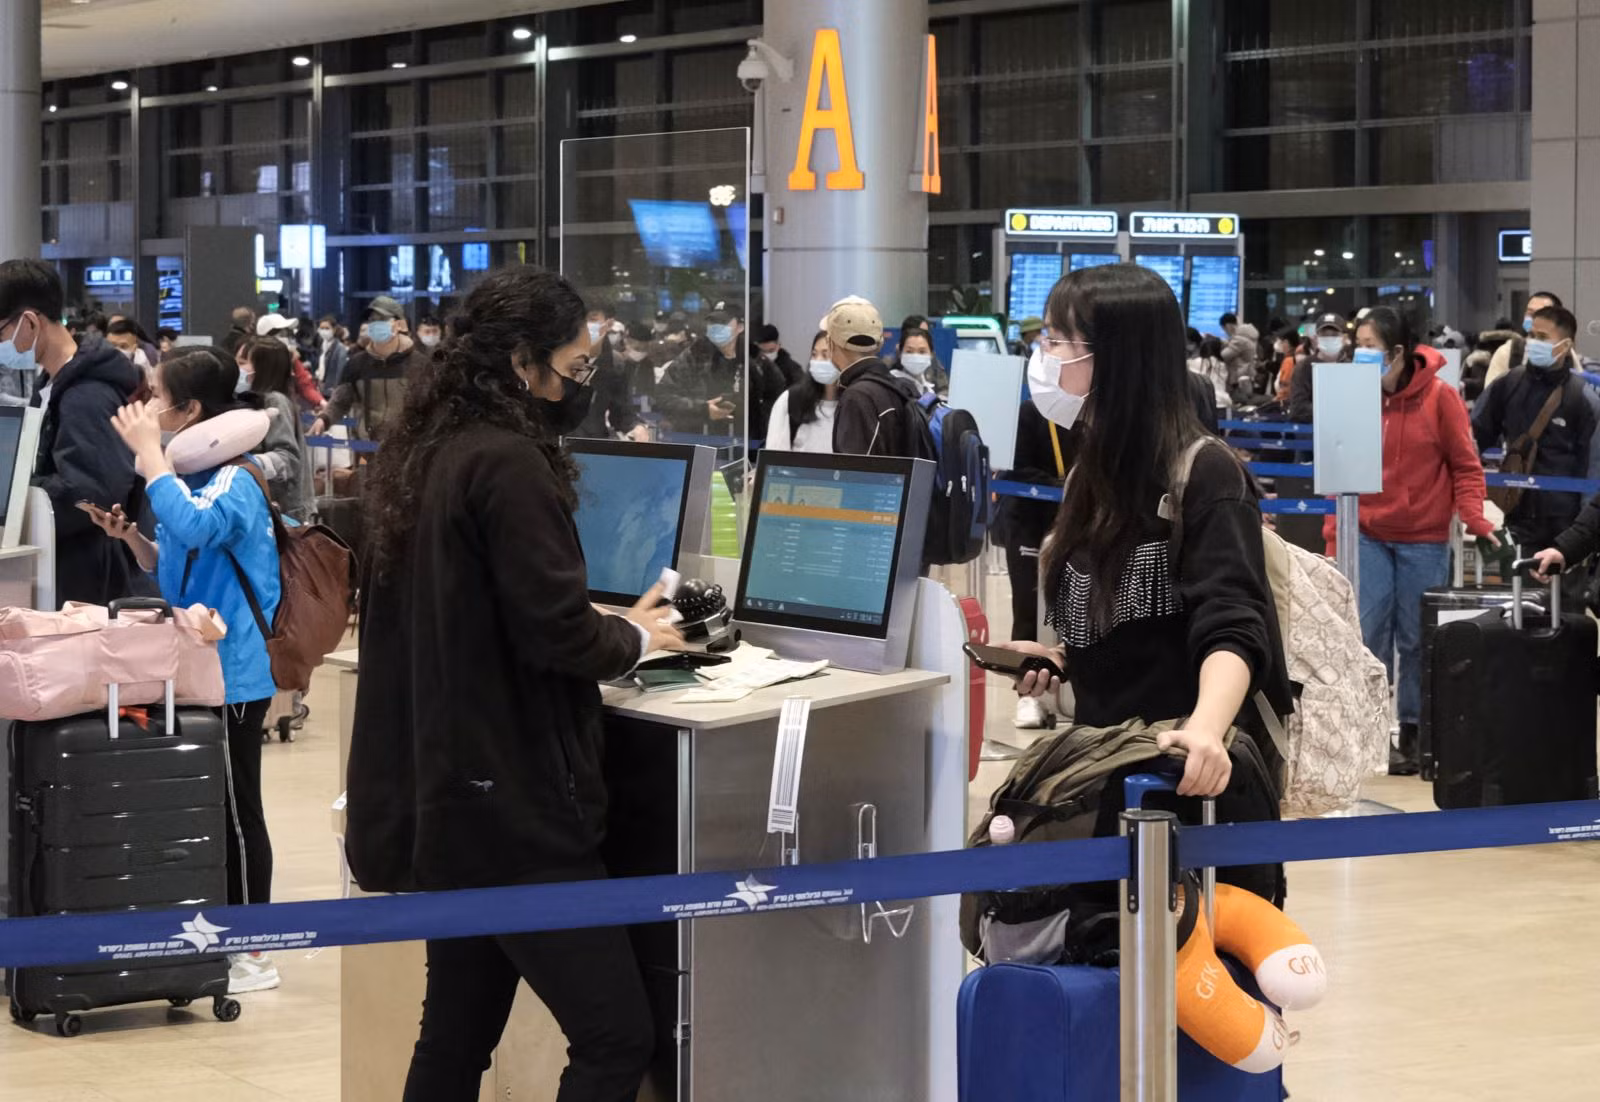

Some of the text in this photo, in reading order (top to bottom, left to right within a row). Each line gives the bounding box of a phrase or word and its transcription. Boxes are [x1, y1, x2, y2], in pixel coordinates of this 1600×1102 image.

[788, 28, 864, 191] A
[922, 34, 941, 194] A
[1030, 215, 1112, 231] DEPARTURES
[1143, 217, 1210, 233] המראות
